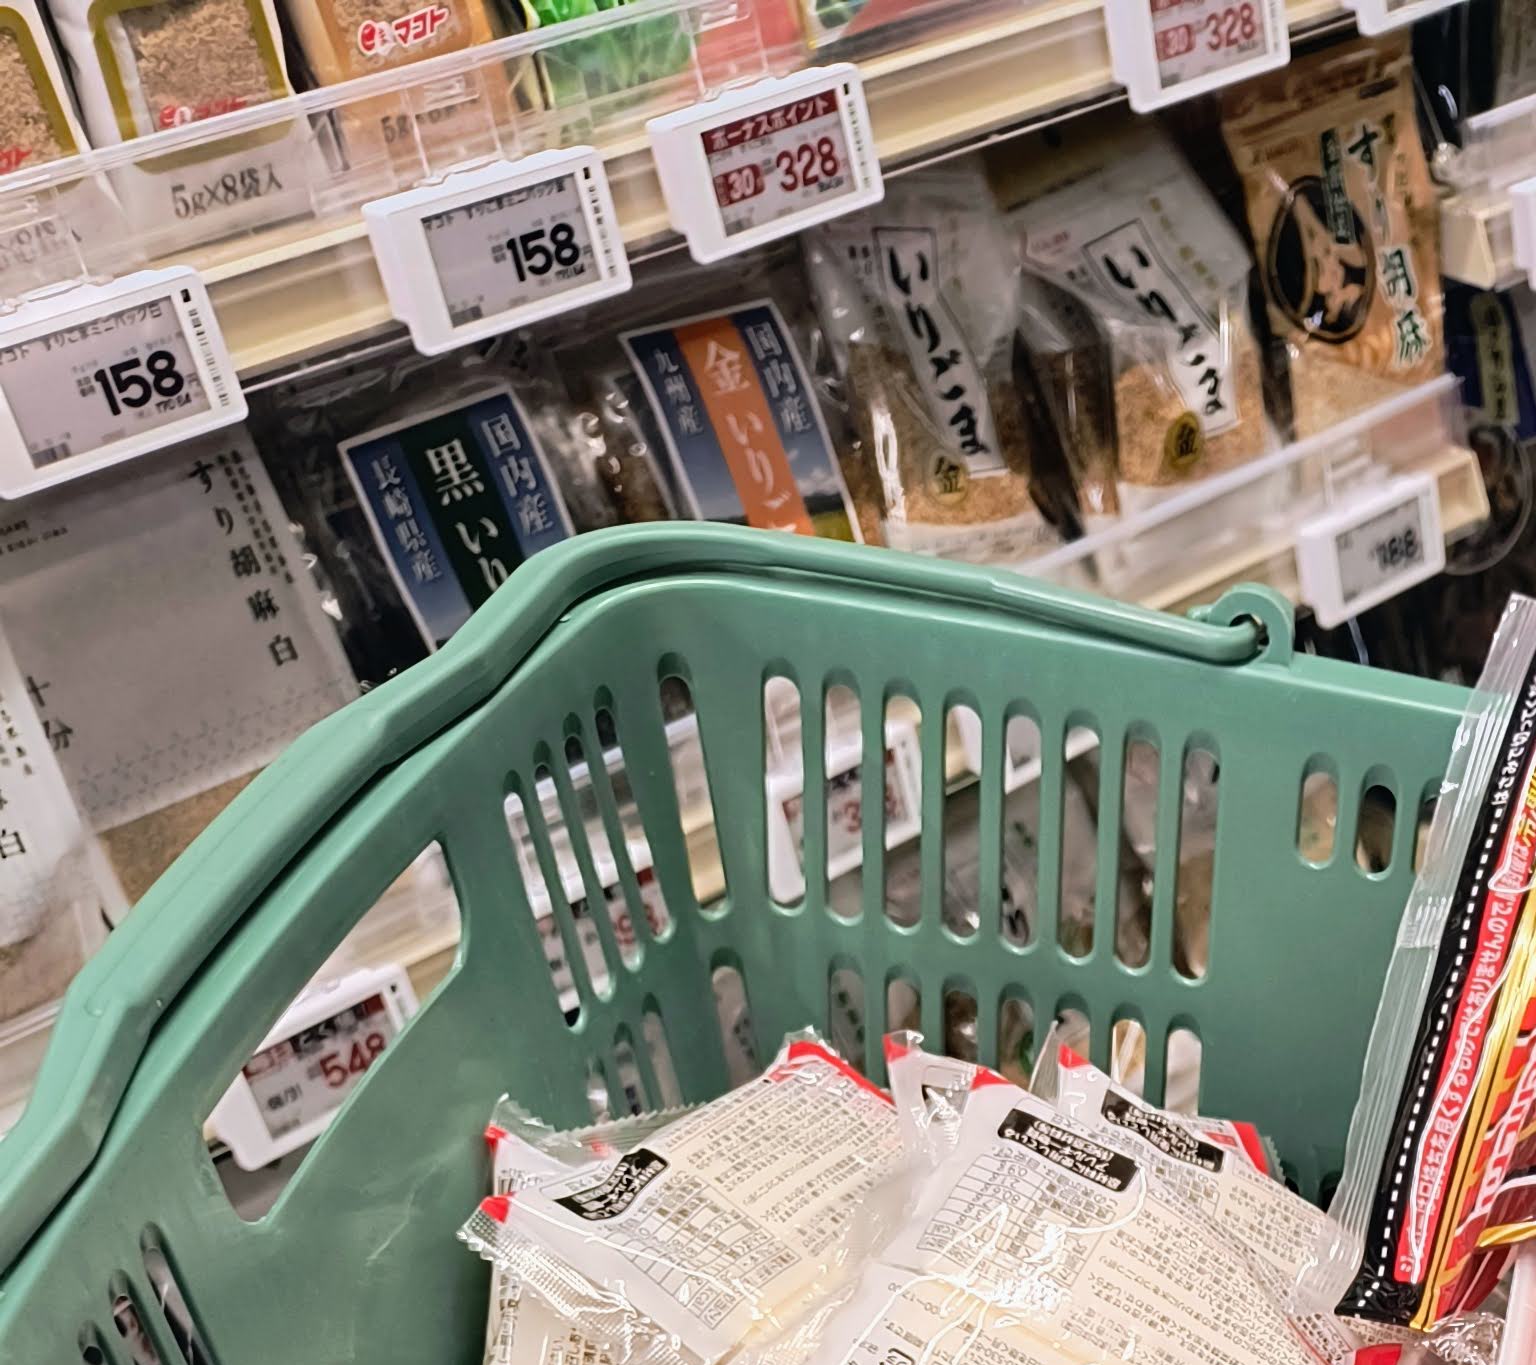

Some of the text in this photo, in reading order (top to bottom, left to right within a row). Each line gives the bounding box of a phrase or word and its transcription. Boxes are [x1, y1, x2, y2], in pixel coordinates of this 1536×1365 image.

[393, 2, 449, 49] マコト
[1201, 2, 1259, 51] 328
[709, 94, 831, 150] ボーナスポイント
[771, 135, 841, 193] 328
[505, 220, 583, 282] 158
[92, 346, 187, 418] 158
[748, 322, 813, 434] 国内産
[485, 415, 557, 535] 国内産
